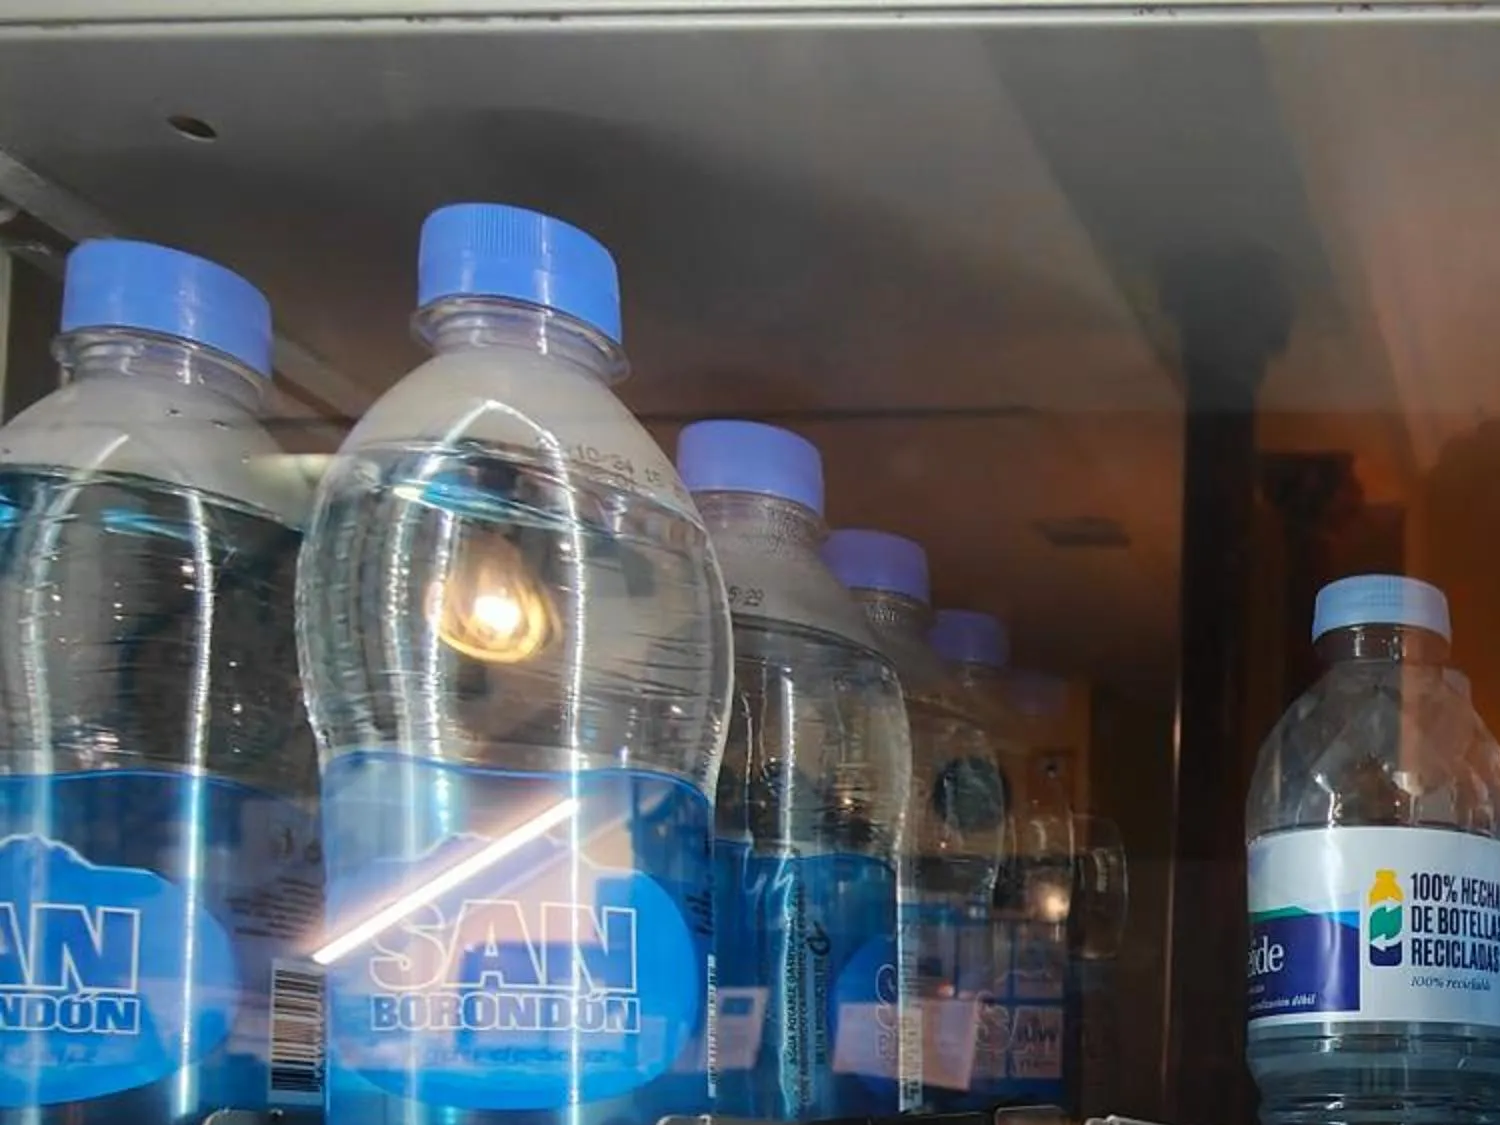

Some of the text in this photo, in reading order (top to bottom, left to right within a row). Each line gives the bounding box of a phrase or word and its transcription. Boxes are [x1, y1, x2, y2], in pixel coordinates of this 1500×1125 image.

[1411, 873, 1500, 910] 100% HECHA
[1411, 906, 1435, 933] DE
[0, 902, 141, 994] AN
[369, 898, 638, 994] SAN
[1411, 939, 1500, 974] RECICLADAS
[0, 992, 141, 1036] NDÓN
[370, 991, 641, 1034] BORONDÓN
